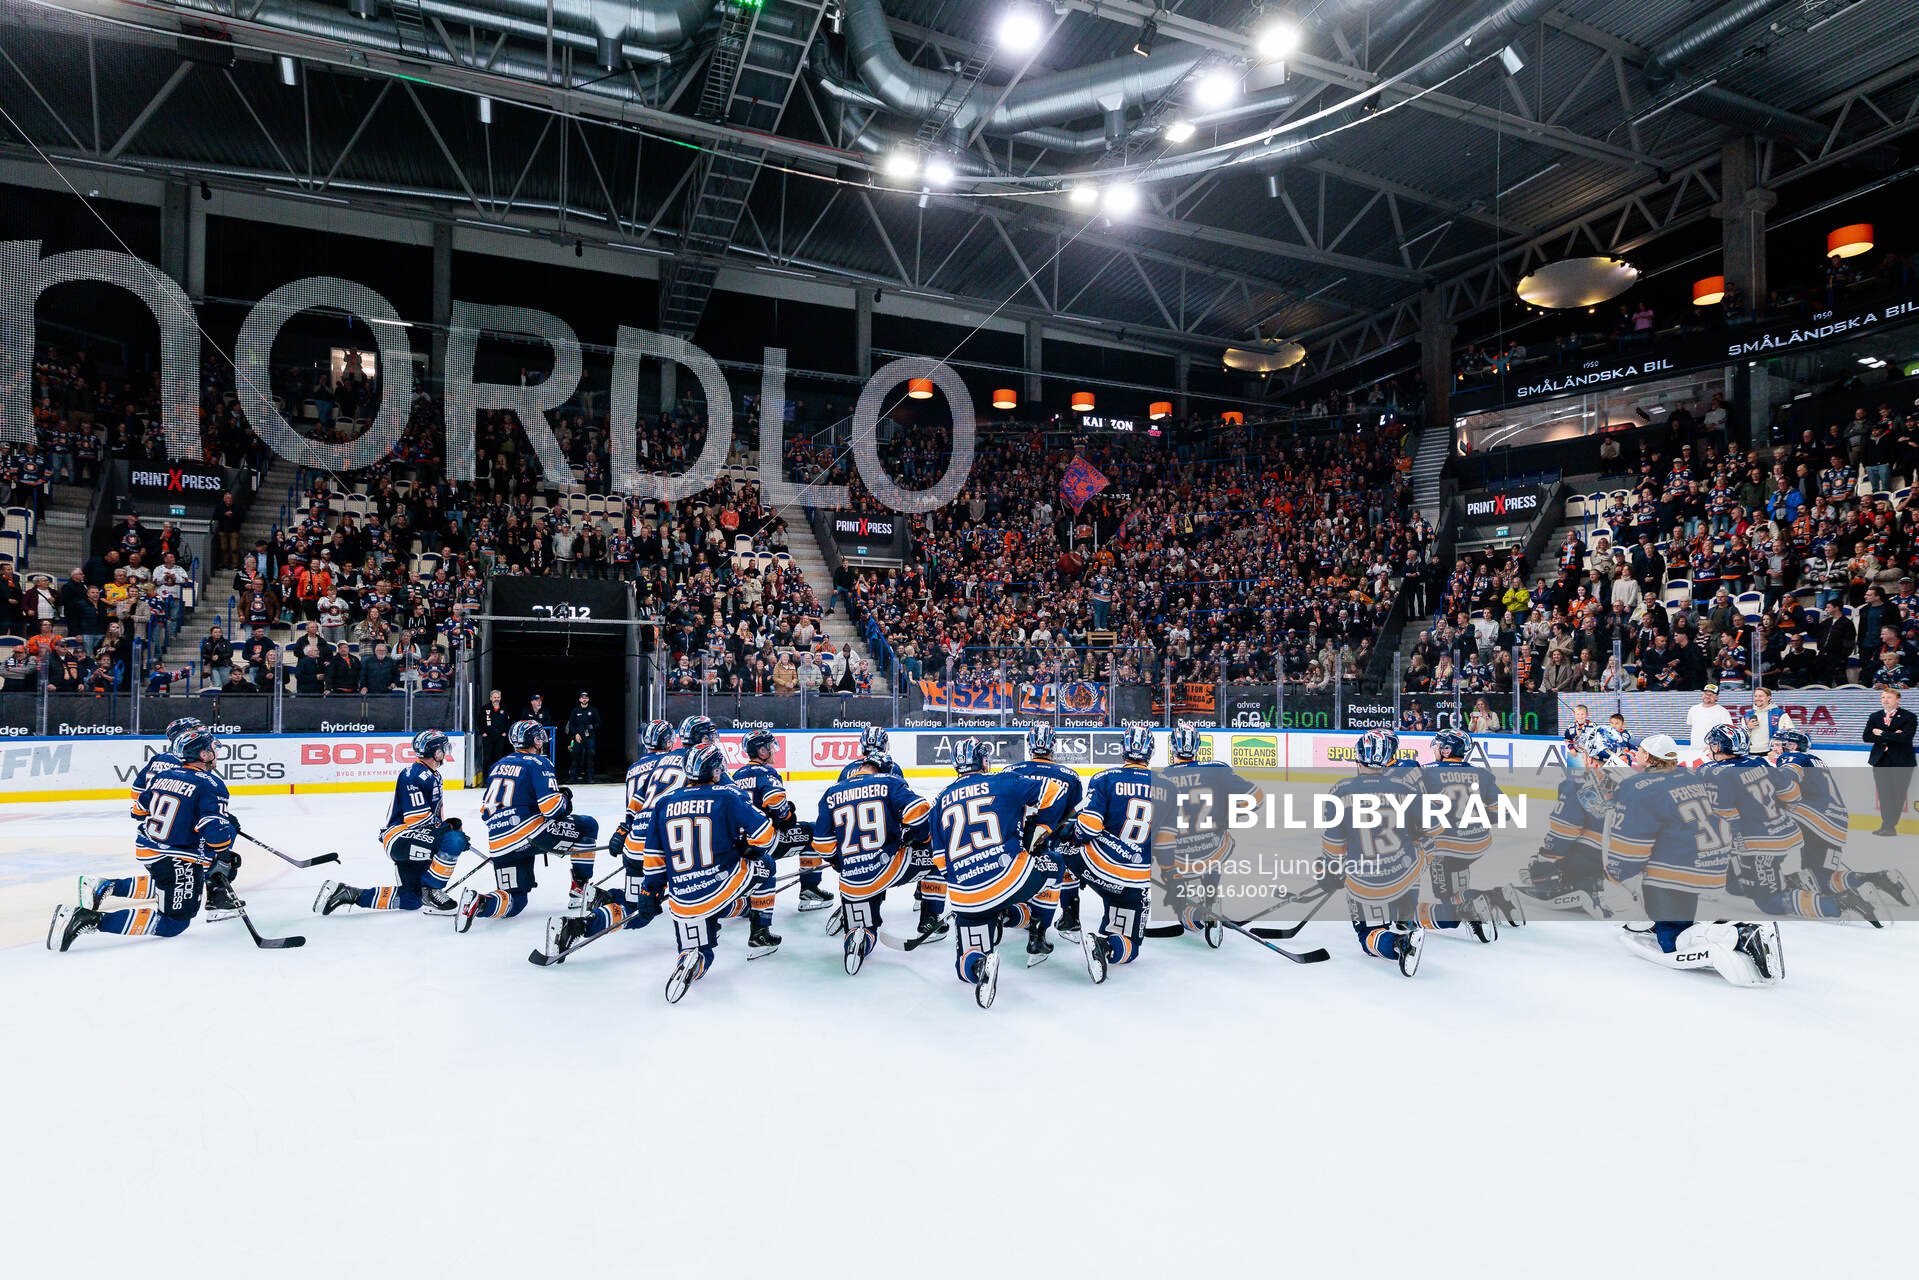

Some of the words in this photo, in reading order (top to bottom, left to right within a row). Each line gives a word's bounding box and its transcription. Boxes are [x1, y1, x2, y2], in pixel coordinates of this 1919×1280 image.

[1728, 313, 1878, 356] SMÅLÄNDSKA
[1885, 301, 1919, 318] BIL
[1517, 366, 1638, 398] SMÅLÄNDSKA
[1644, 359, 1674, 373] BIL
[132, 468, 221, 491] PRINTXPRESS
[1467, 495, 1537, 515] PRINTXPRESS
[836, 518, 892, 536] PRINTXPRESS
[1348, 704, 1394, 714] Revision
[59, 722, 123, 736] Hybridge
[208, 723, 241, 735] ridge
[321, 721, 375, 733] Hybridge
[732, 719, 774, 729] Hybridge
[833, 719, 872, 729] Hybridge
[904, 718, 942, 728] Hybridge
[957, 718, 995, 728] Hybridge
[1065, 718, 1103, 728] Hybridge
[301, 743, 455, 765] BORG
[1233, 748, 1276, 758] GOTLANDS
[1233, 757, 1264, 767] BYGGEN
[1266, 758, 1276, 767] AB
[1439, 771, 1480, 785] COOPER
[408, 791, 425, 807] 10
[484, 777, 516, 816] 41
[826, 783, 889, 809] STRANDBERG
[941, 782, 990, 808] ELVENES
[666, 799, 715, 818] ROBERT
[833, 800, 887, 857] 29
[942, 795, 1003, 862] 25
[1118, 797, 1155, 845] 8
[664, 816, 715, 874] 91
[953, 844, 1006, 872] SVETRUCK
[1554, 895, 1580, 905] CCM
[1675, 950, 1709, 962] CCM
